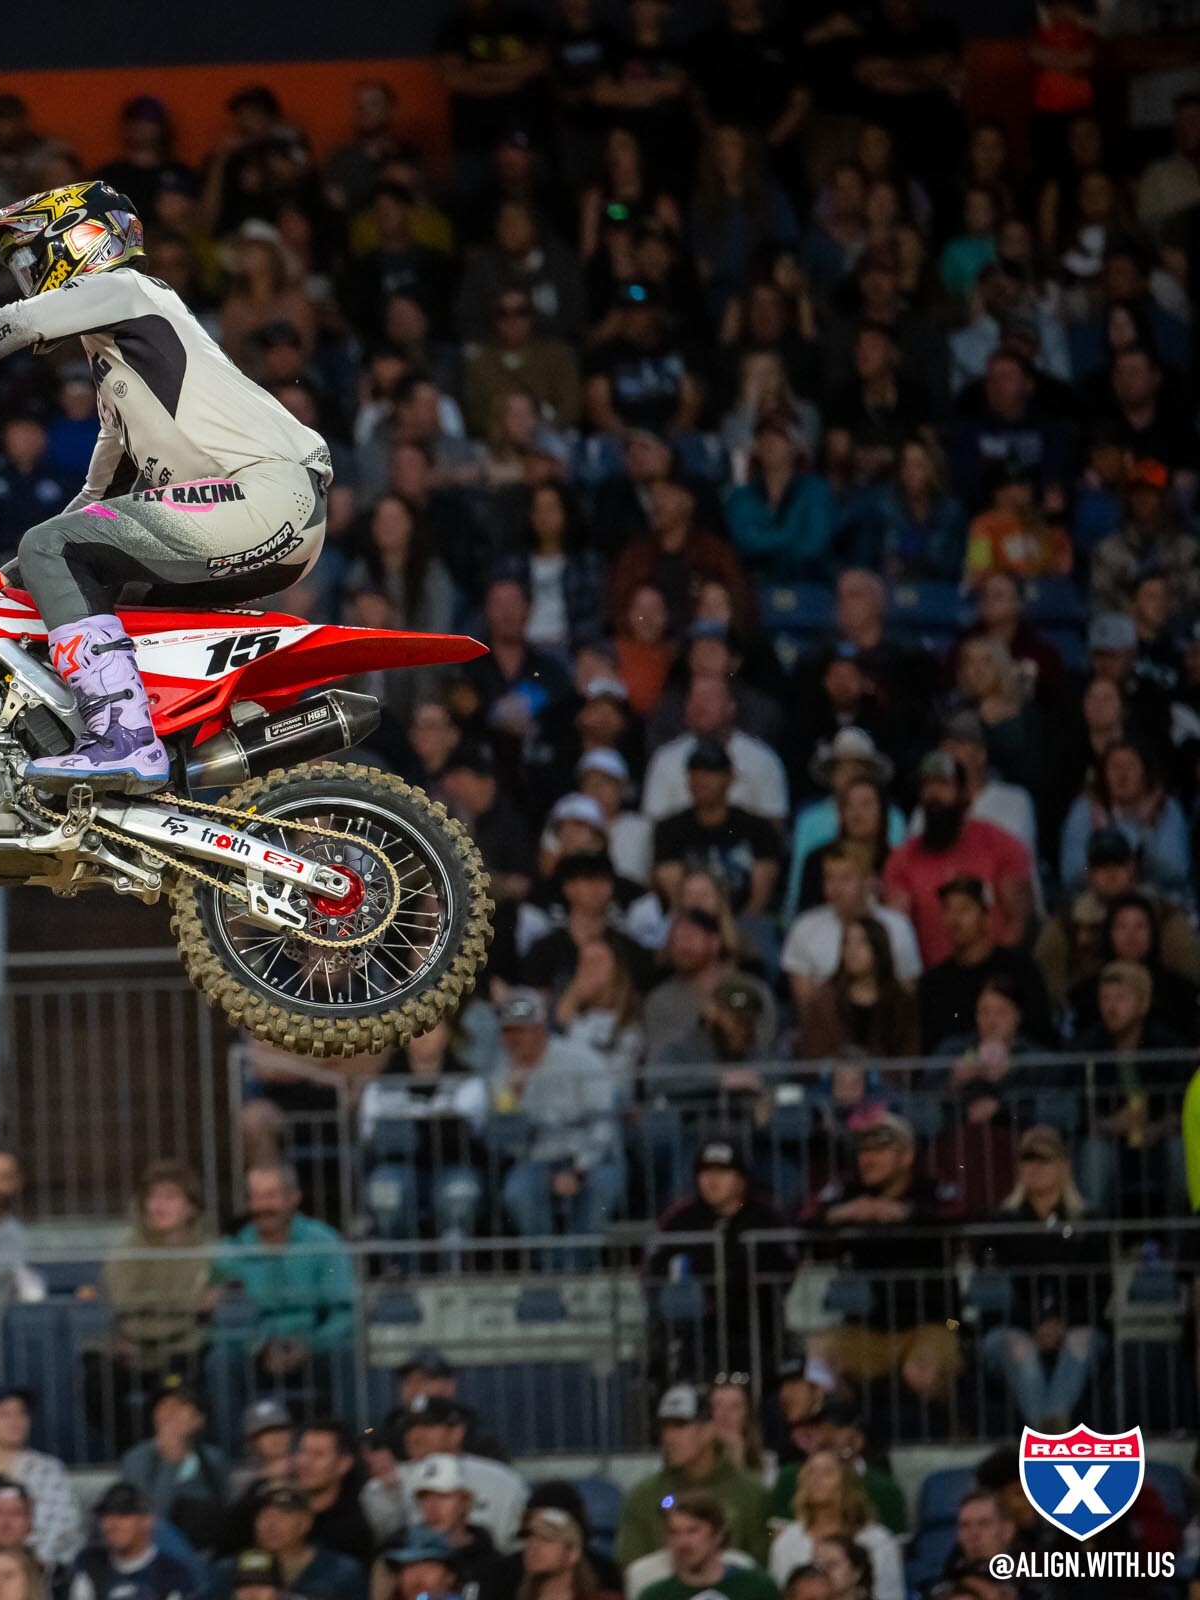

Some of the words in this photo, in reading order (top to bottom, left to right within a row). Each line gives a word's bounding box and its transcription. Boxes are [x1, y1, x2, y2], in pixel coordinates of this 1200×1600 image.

[132, 489, 166, 502] FLY
[209, 555, 242, 568] FIRE
[244, 523, 292, 562] POWER
[233, 538, 300, 573] HONDA
[205, 629, 281, 677] 15
[307, 708, 328, 723] HGS
[200, 828, 251, 856] froth
